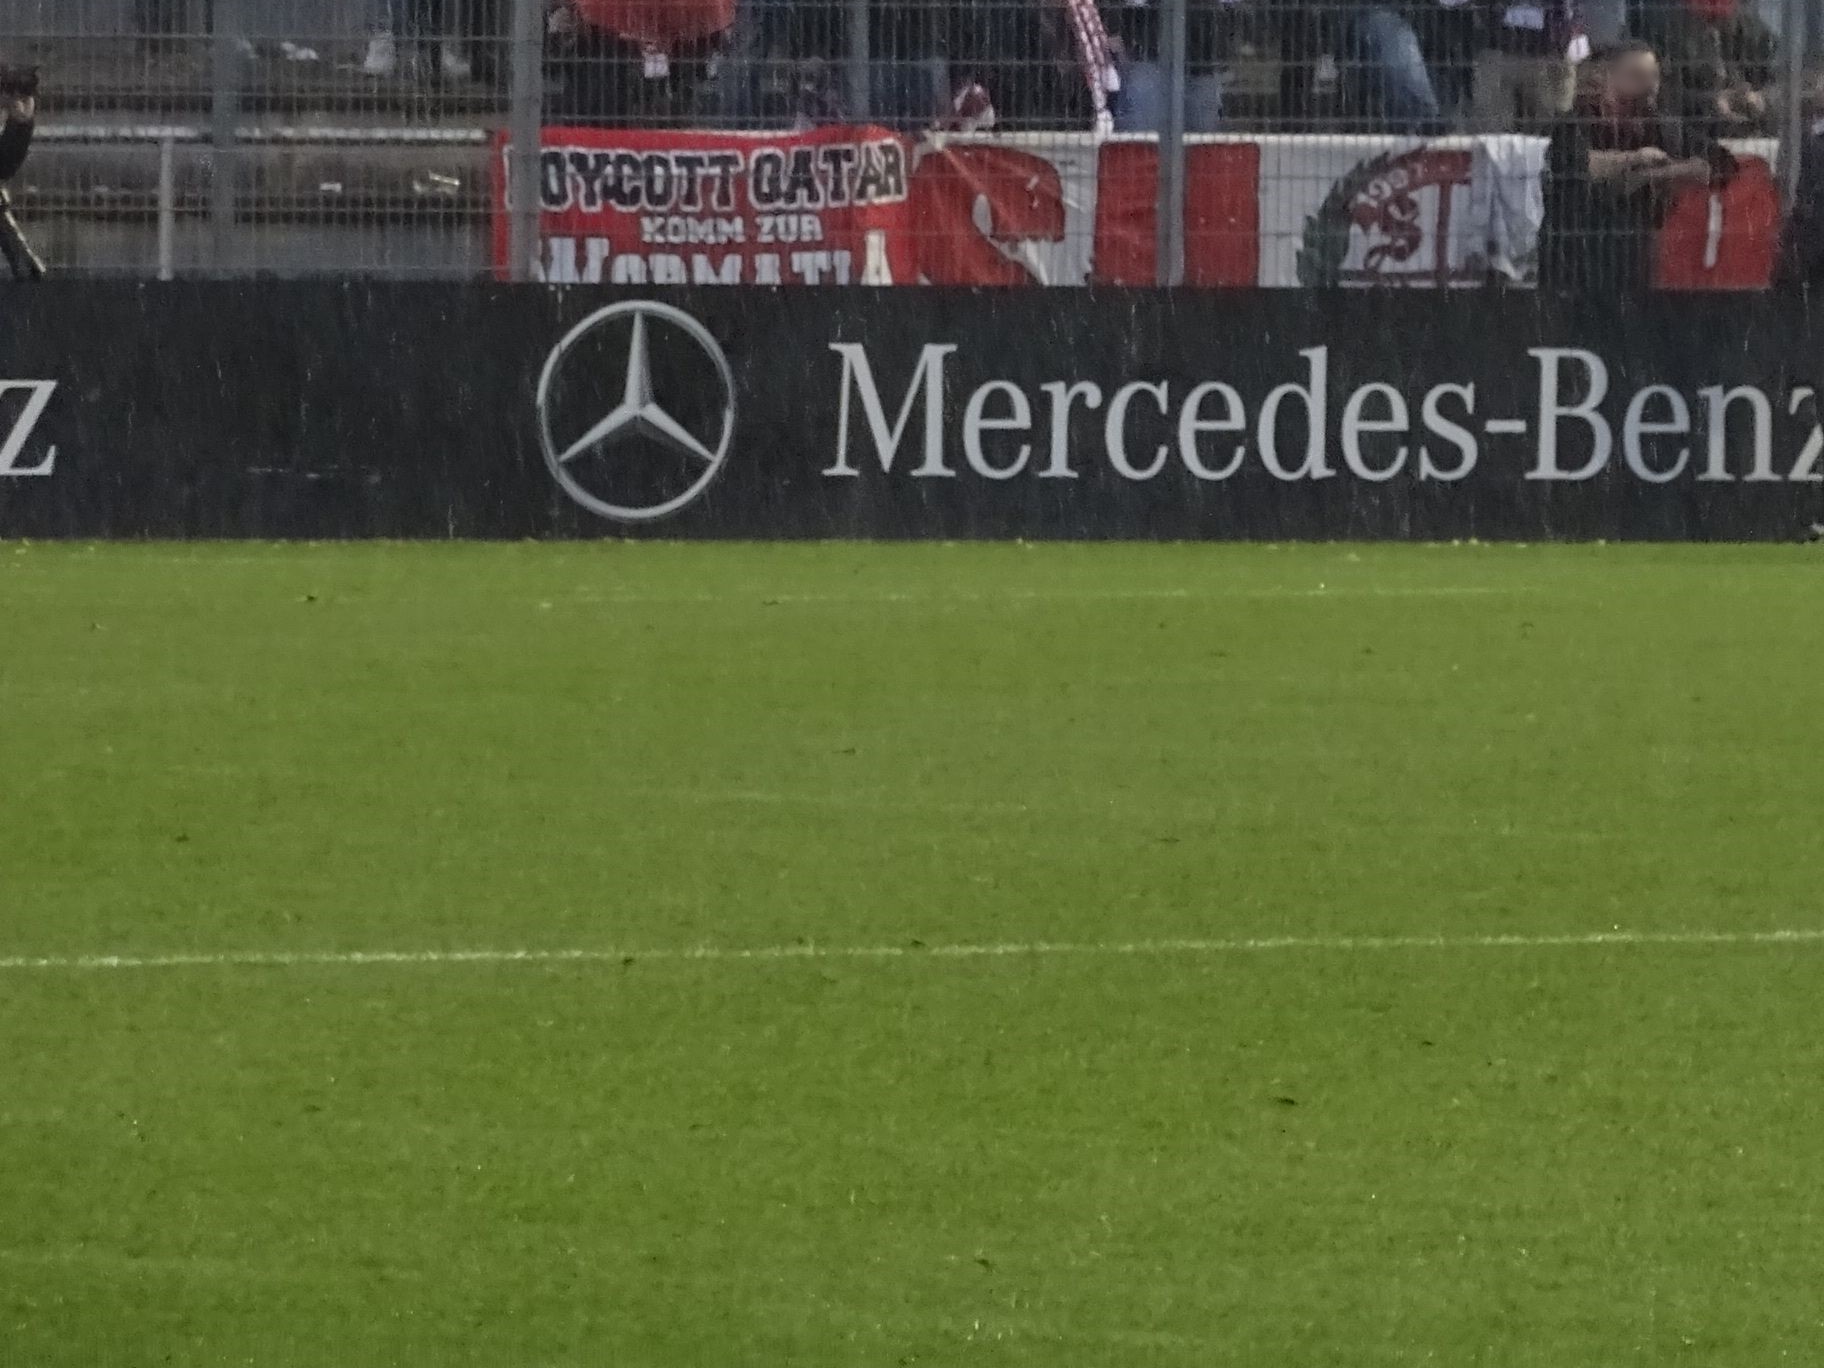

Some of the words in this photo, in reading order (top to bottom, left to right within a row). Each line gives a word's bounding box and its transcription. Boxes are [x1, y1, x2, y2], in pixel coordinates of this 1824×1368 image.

[503, 146, 743, 212] OYCOTT
[748, 137, 907, 212] QATAR
[640, 215, 746, 245] KOMM
[754, 213, 824, 243] ZUR
